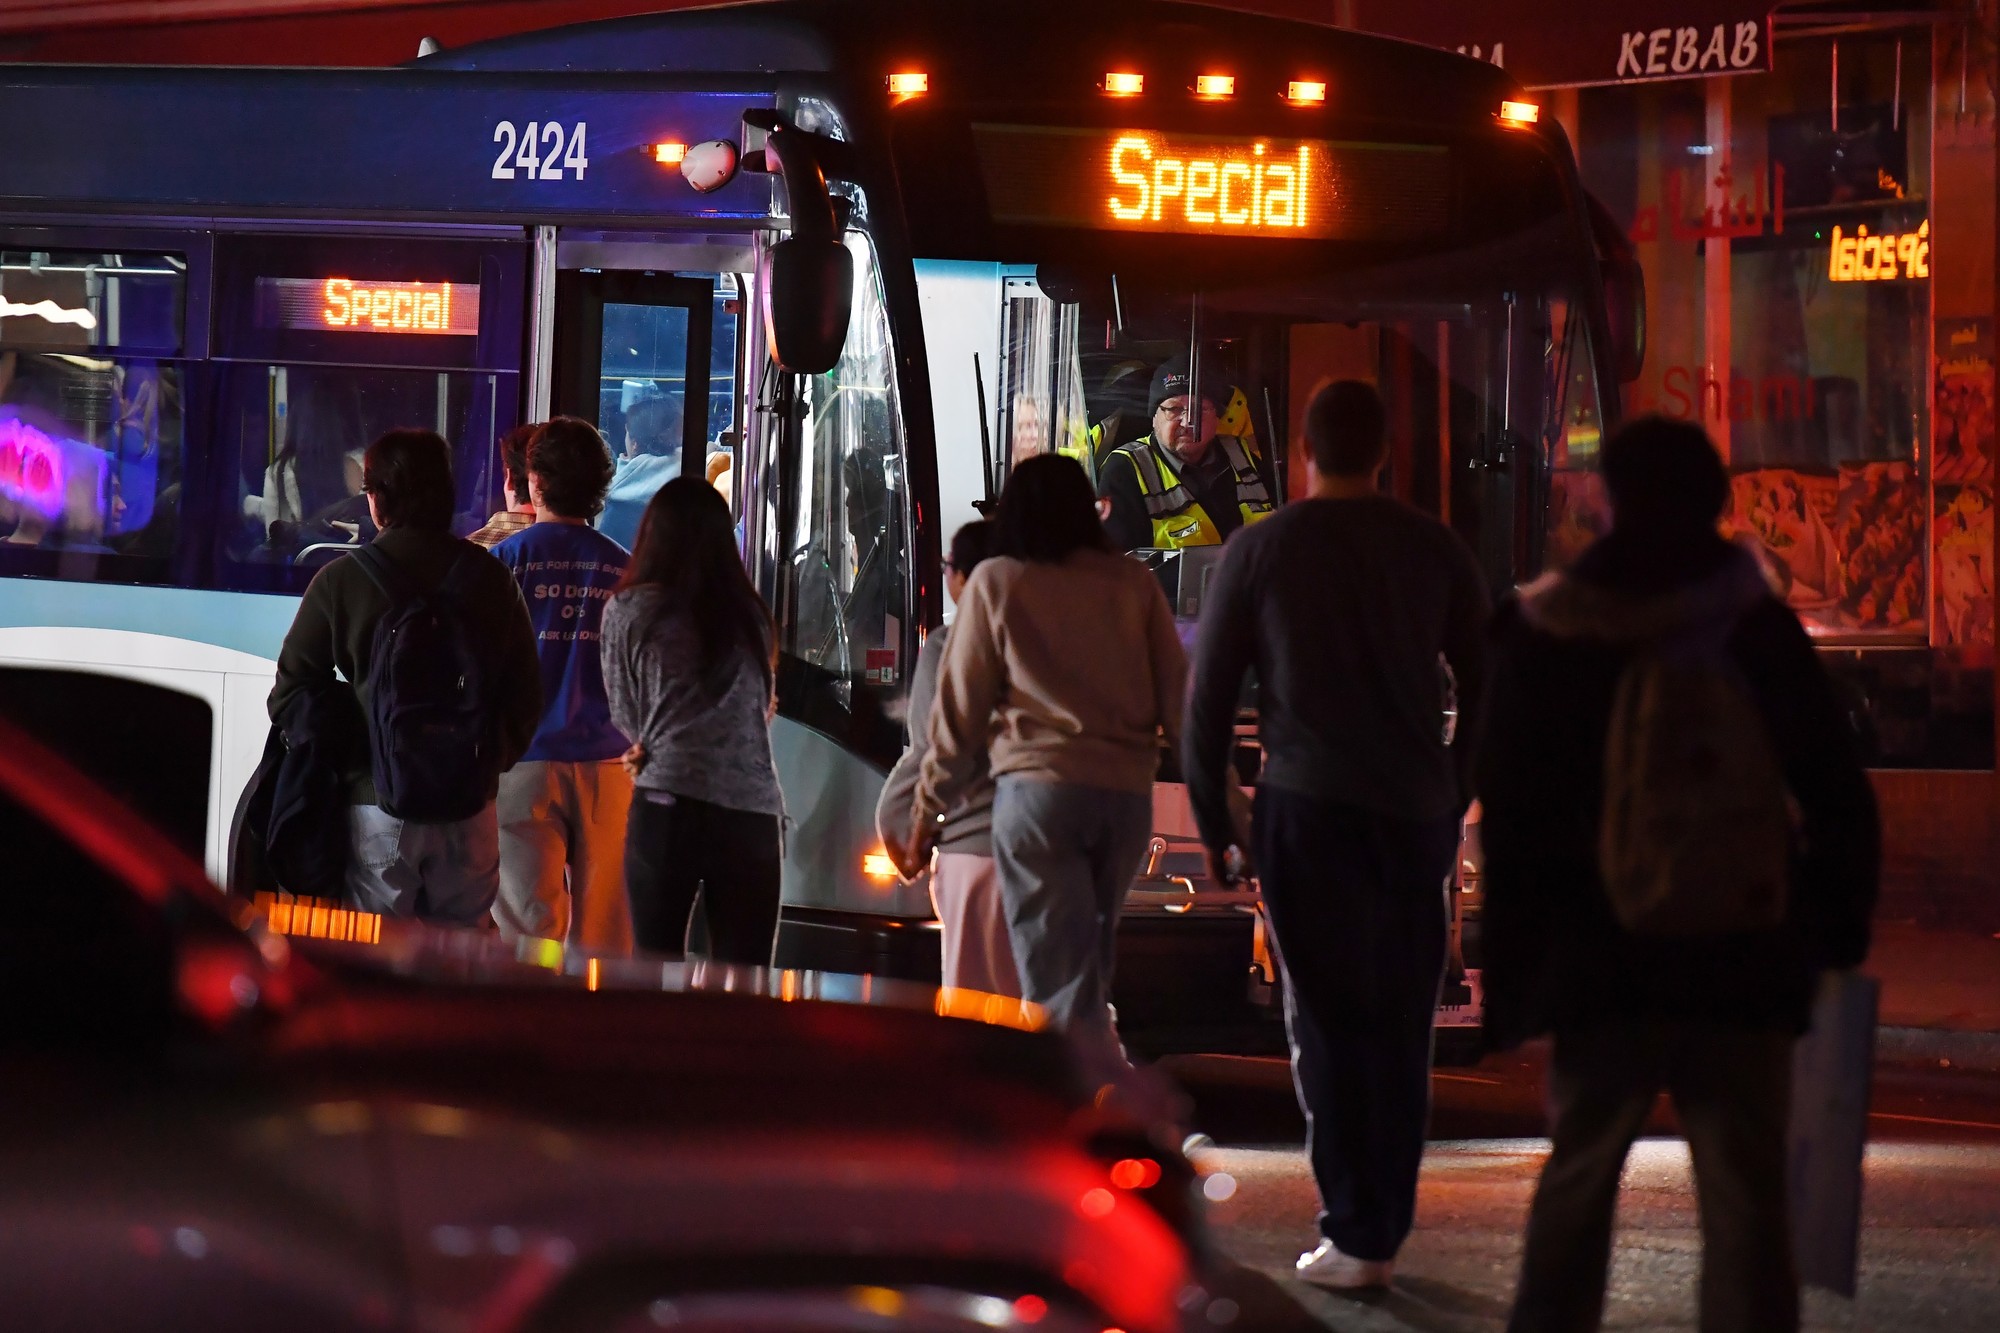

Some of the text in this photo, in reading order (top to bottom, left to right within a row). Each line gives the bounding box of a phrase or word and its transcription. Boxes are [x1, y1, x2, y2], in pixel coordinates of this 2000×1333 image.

[1616, 20, 1759, 77] KEBAB
[491, 120, 589, 181] 2424
[1108, 136, 1311, 228] Special
[324, 277, 452, 330] Special
[547, 561, 570, 570] FOR
[603, 564, 625, 576] EVE
[534, 583, 561, 600] SO
[561, 604, 586, 619] 0%
[538, 629, 560, 641] ASK
